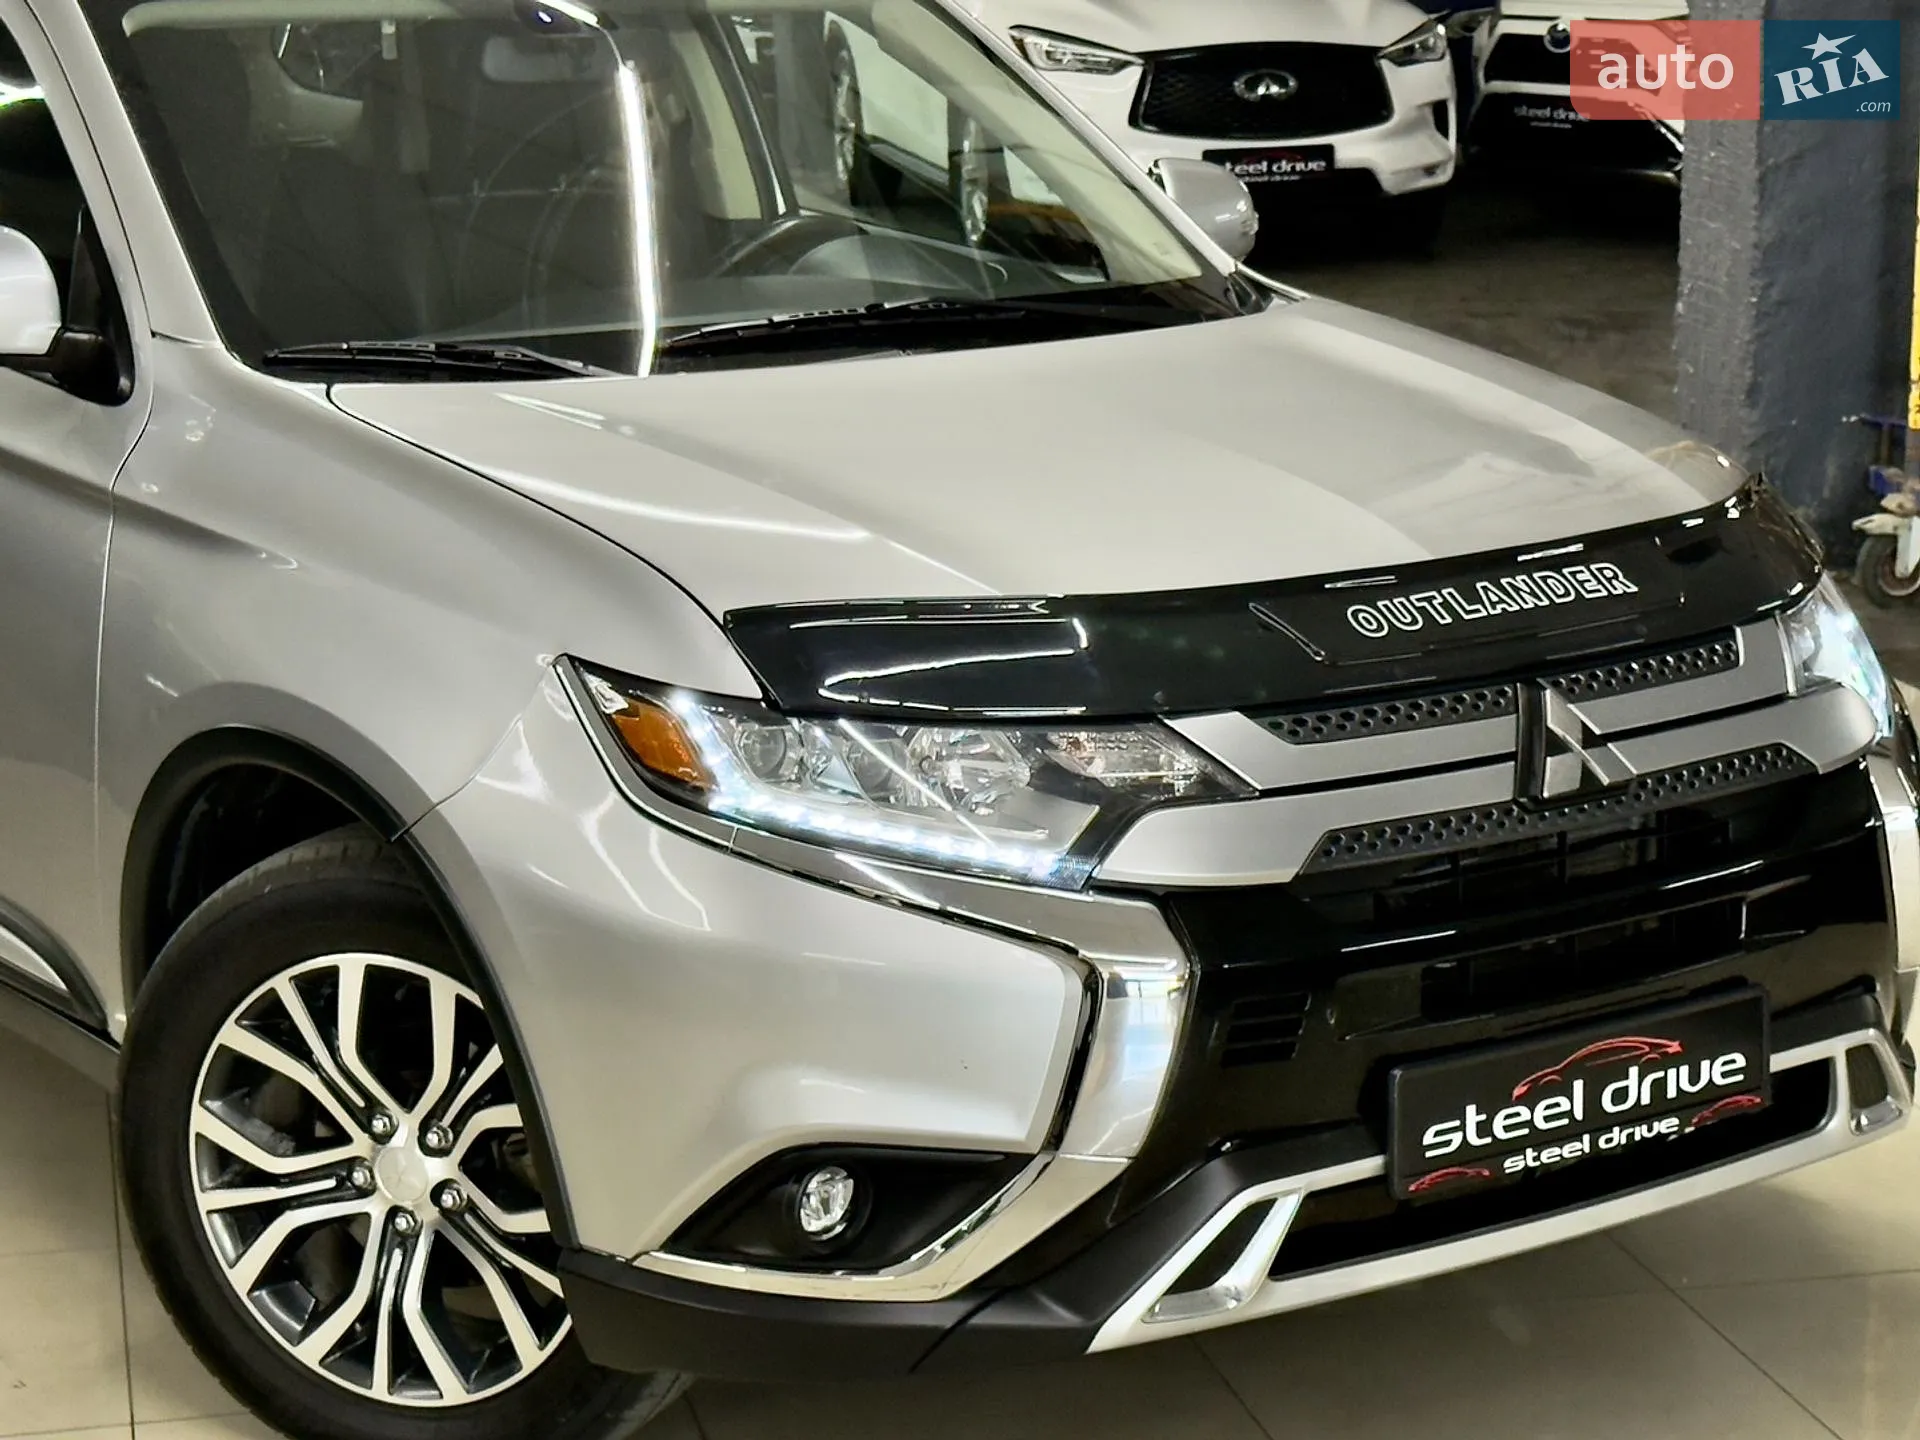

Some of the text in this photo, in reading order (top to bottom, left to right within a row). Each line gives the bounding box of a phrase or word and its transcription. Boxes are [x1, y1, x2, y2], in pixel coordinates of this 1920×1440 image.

[1224, 159, 1326, 175] teel drive
[1346, 562, 1639, 638] OUTLANDER
[1422, 1052, 1747, 1159] steel drive
[1503, 1116, 1680, 1173] steel drive
